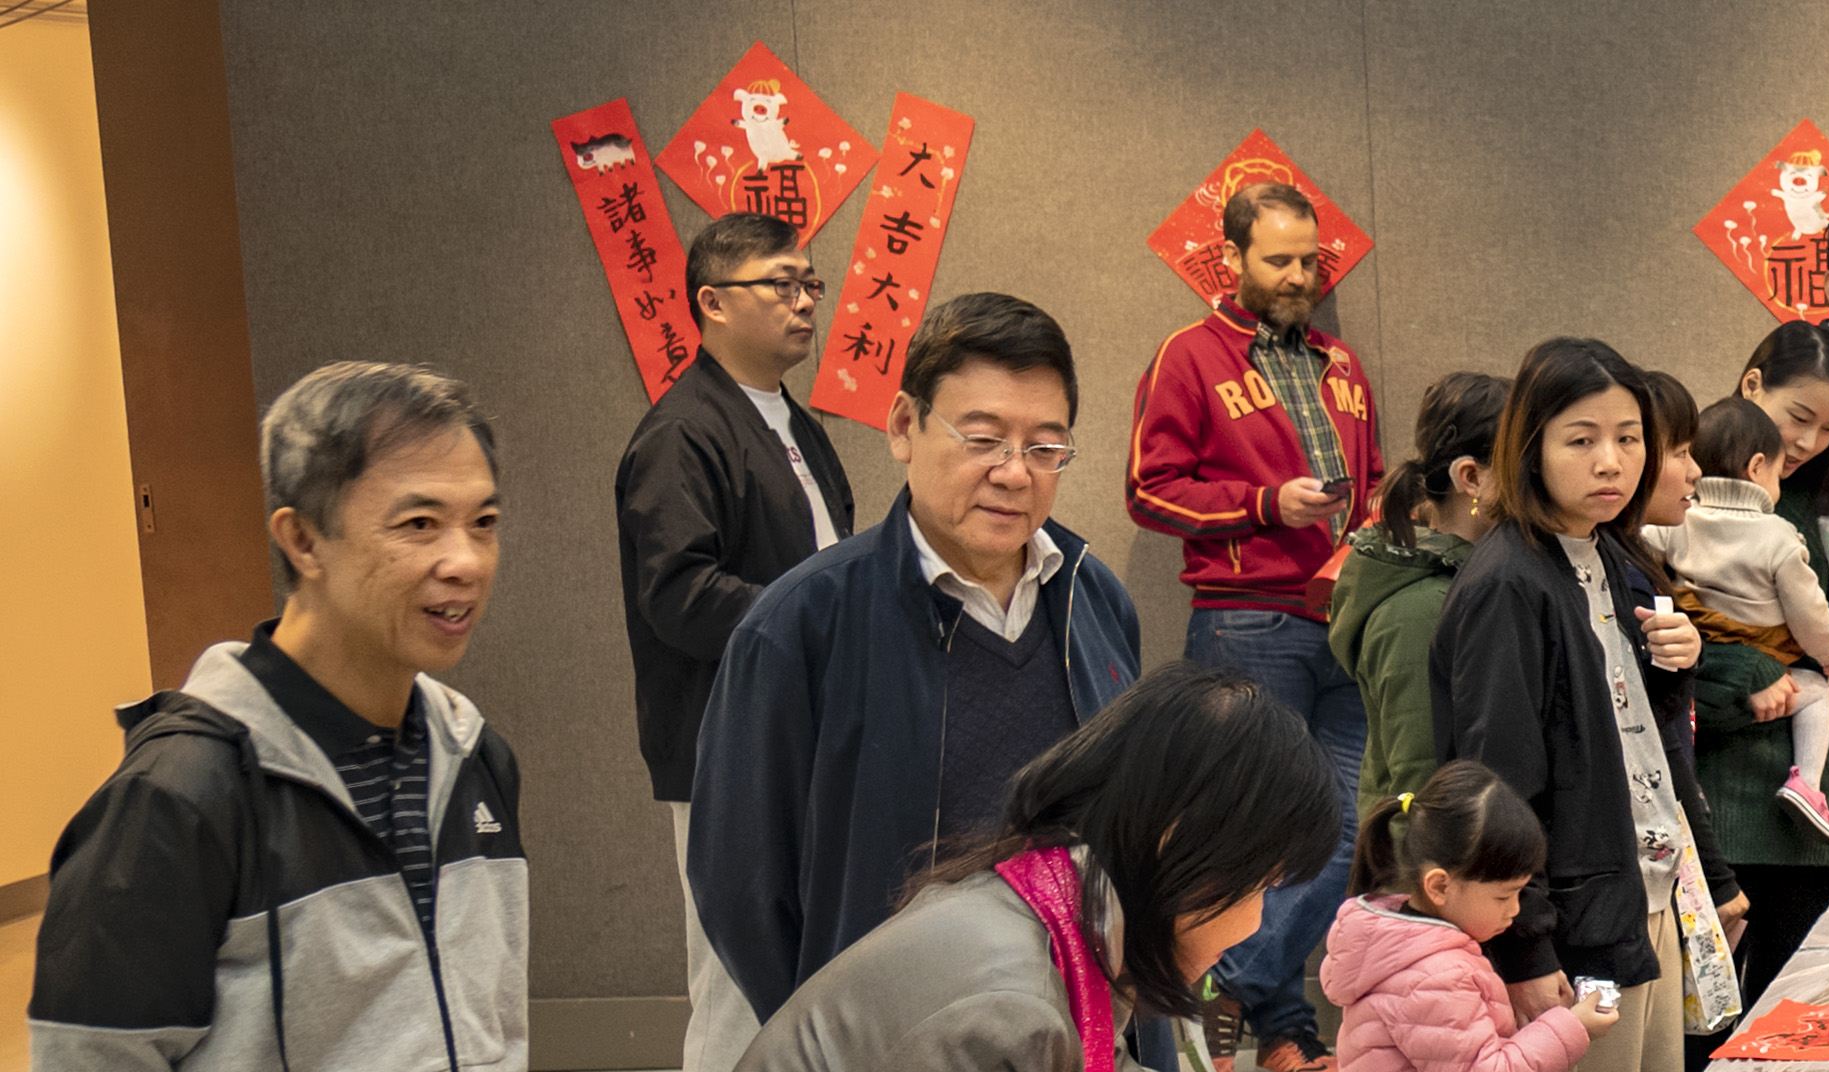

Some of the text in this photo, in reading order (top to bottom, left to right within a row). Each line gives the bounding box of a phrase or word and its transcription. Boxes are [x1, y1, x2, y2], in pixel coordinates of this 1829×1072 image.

[742, 164, 807, 229] 福
[842, 142, 936, 375] 大吉大利
